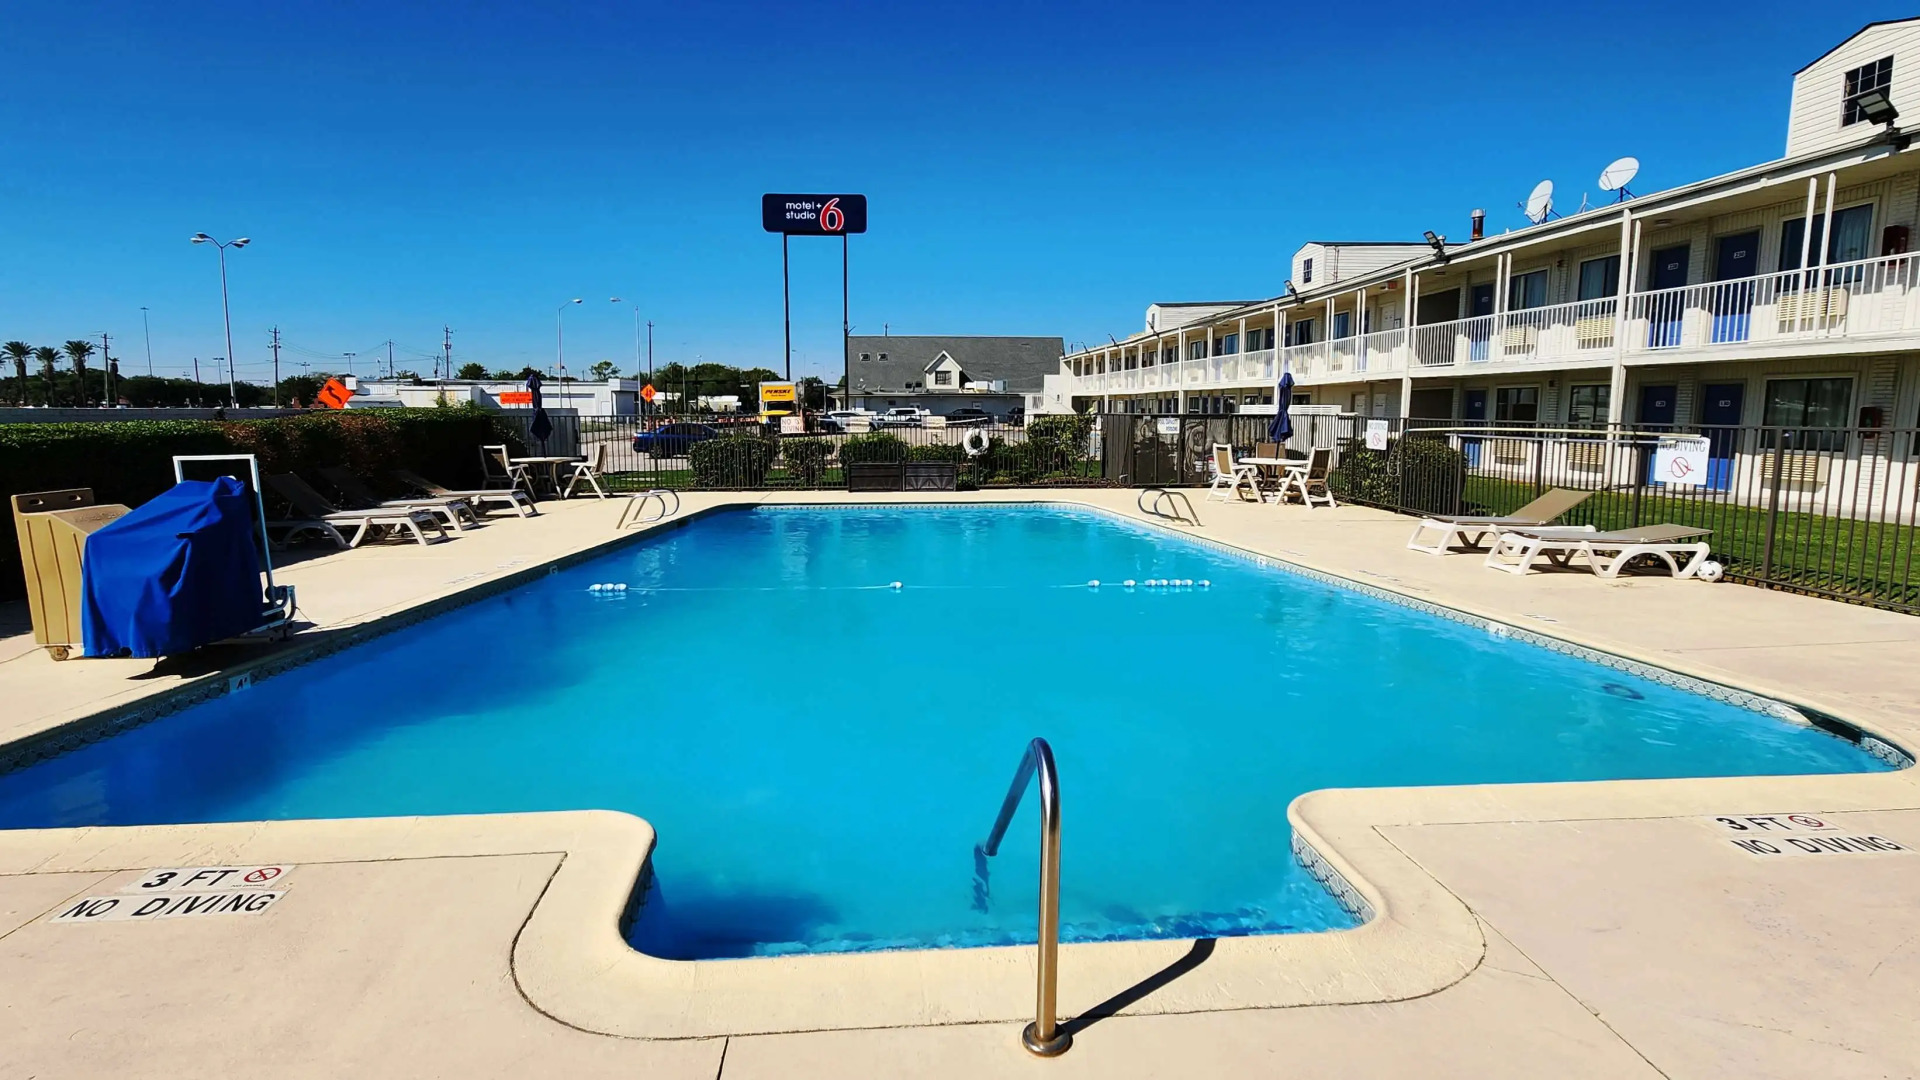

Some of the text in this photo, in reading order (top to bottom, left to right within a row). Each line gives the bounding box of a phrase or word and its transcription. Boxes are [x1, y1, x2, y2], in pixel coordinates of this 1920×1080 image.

[785, 201, 815, 210] motel
[785, 211, 816, 219] studio
[819, 197, 845, 231] 6
[1675, 440, 1706, 452] DIVING
[1716, 817, 1792, 831] 3 FT
[1731, 836, 1905, 854] NO DIVING
[141, 869, 240, 888] 3 FT
[59, 893, 276, 918] NO DIVING
